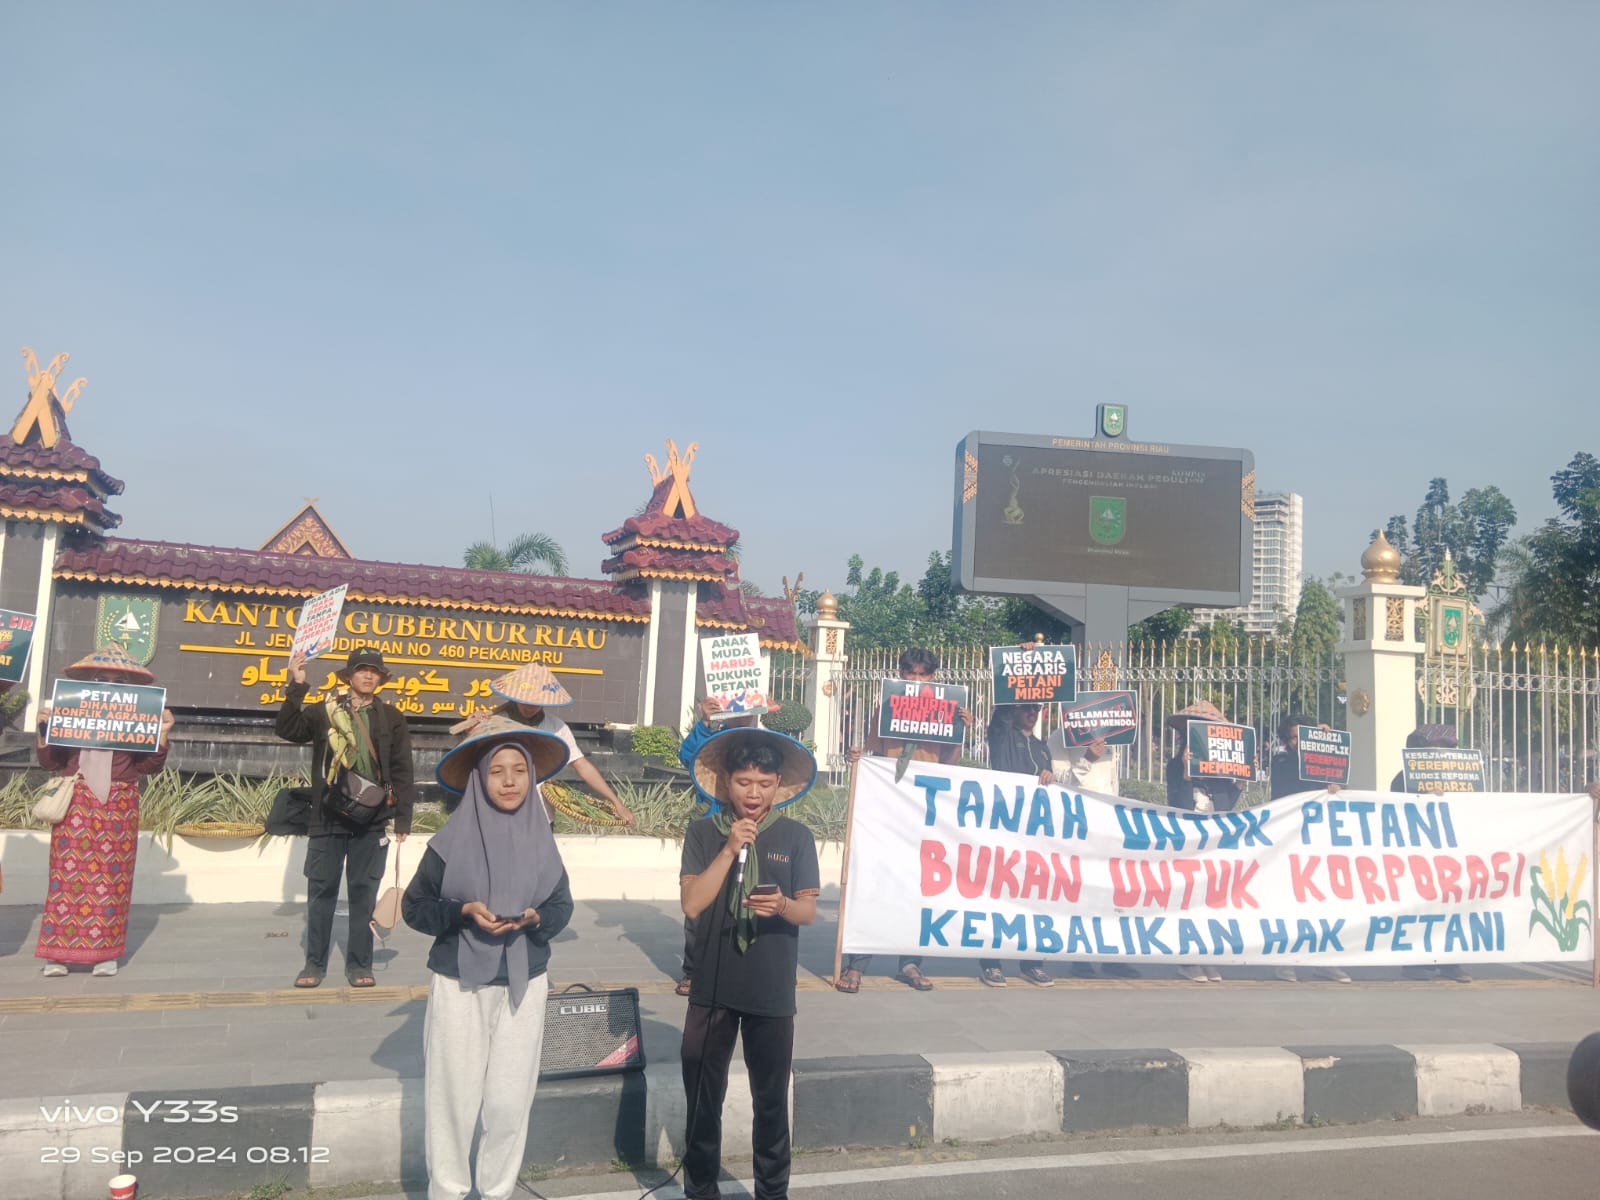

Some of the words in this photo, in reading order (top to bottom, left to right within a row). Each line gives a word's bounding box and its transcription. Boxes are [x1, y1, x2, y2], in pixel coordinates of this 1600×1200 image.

[1052, 438, 1106, 449] PEMERINTAH
[1108, 441, 1148, 452] PROVINSI
[184, 598, 305, 629] KANTO
[345, 611, 528, 645] GUBERNUR
[533, 623, 608, 650] RIAU
[234, 631, 256, 646] JL
[407, 642, 431, 656] NO
[438, 645, 465, 658] 460
[470, 647, 563, 664] PEKANBARU
[711, 636, 749, 649] ANAK
[711, 647, 752, 660] MUDA
[1002, 651, 1065, 664] NEGARA
[710, 657, 755, 671] HARUS
[1002, 663, 1067, 677] AGRARIS
[706, 668, 762, 682] DUKUNG
[1007, 675, 1062, 688] PETANI
[711, 679, 759, 693] PETANI
[80, 690, 138, 704] PETANI
[1014, 687, 1055, 700] MIRIS
[80, 700, 137, 713] DIHANTUI
[890, 694, 959, 712] DARURAT
[54, 706, 102, 719] KONFLIK
[106, 712, 159, 723] AGRARIA
[1068, 710, 1133, 720] SELAMATKAN
[51, 715, 158, 735] PEMERINTAH
[890, 719, 954, 738] AGRARIA
[1064, 719, 1098, 729] PULAU
[1100, 718, 1136, 727] MENDOL
[50, 727, 92, 740] SIBUK
[96, 731, 156, 745] PILKADA
[1207, 725, 1243, 740] CABUT
[1207, 737, 1232, 750] PSN
[1234, 740, 1245, 753] DI
[1208, 750, 1245, 764] PULAU
[1199, 761, 1251, 777] REMPANG
[914, 775, 1088, 840] TANAH
[1114, 804, 1273, 851] UNTUK
[1301, 800, 1458, 848] PETANI
[919, 840, 1083, 903] BUKAN
[1109, 857, 1260, 911] UNTUK
[1289, 852, 1526, 905] KORPORASI
[919, 908, 1244, 956] KEMBALIKAN
[1260, 918, 1346, 956] HAK
[1365, 911, 1505, 952] PETANI
[560, 1003, 607, 1015] CUBE
